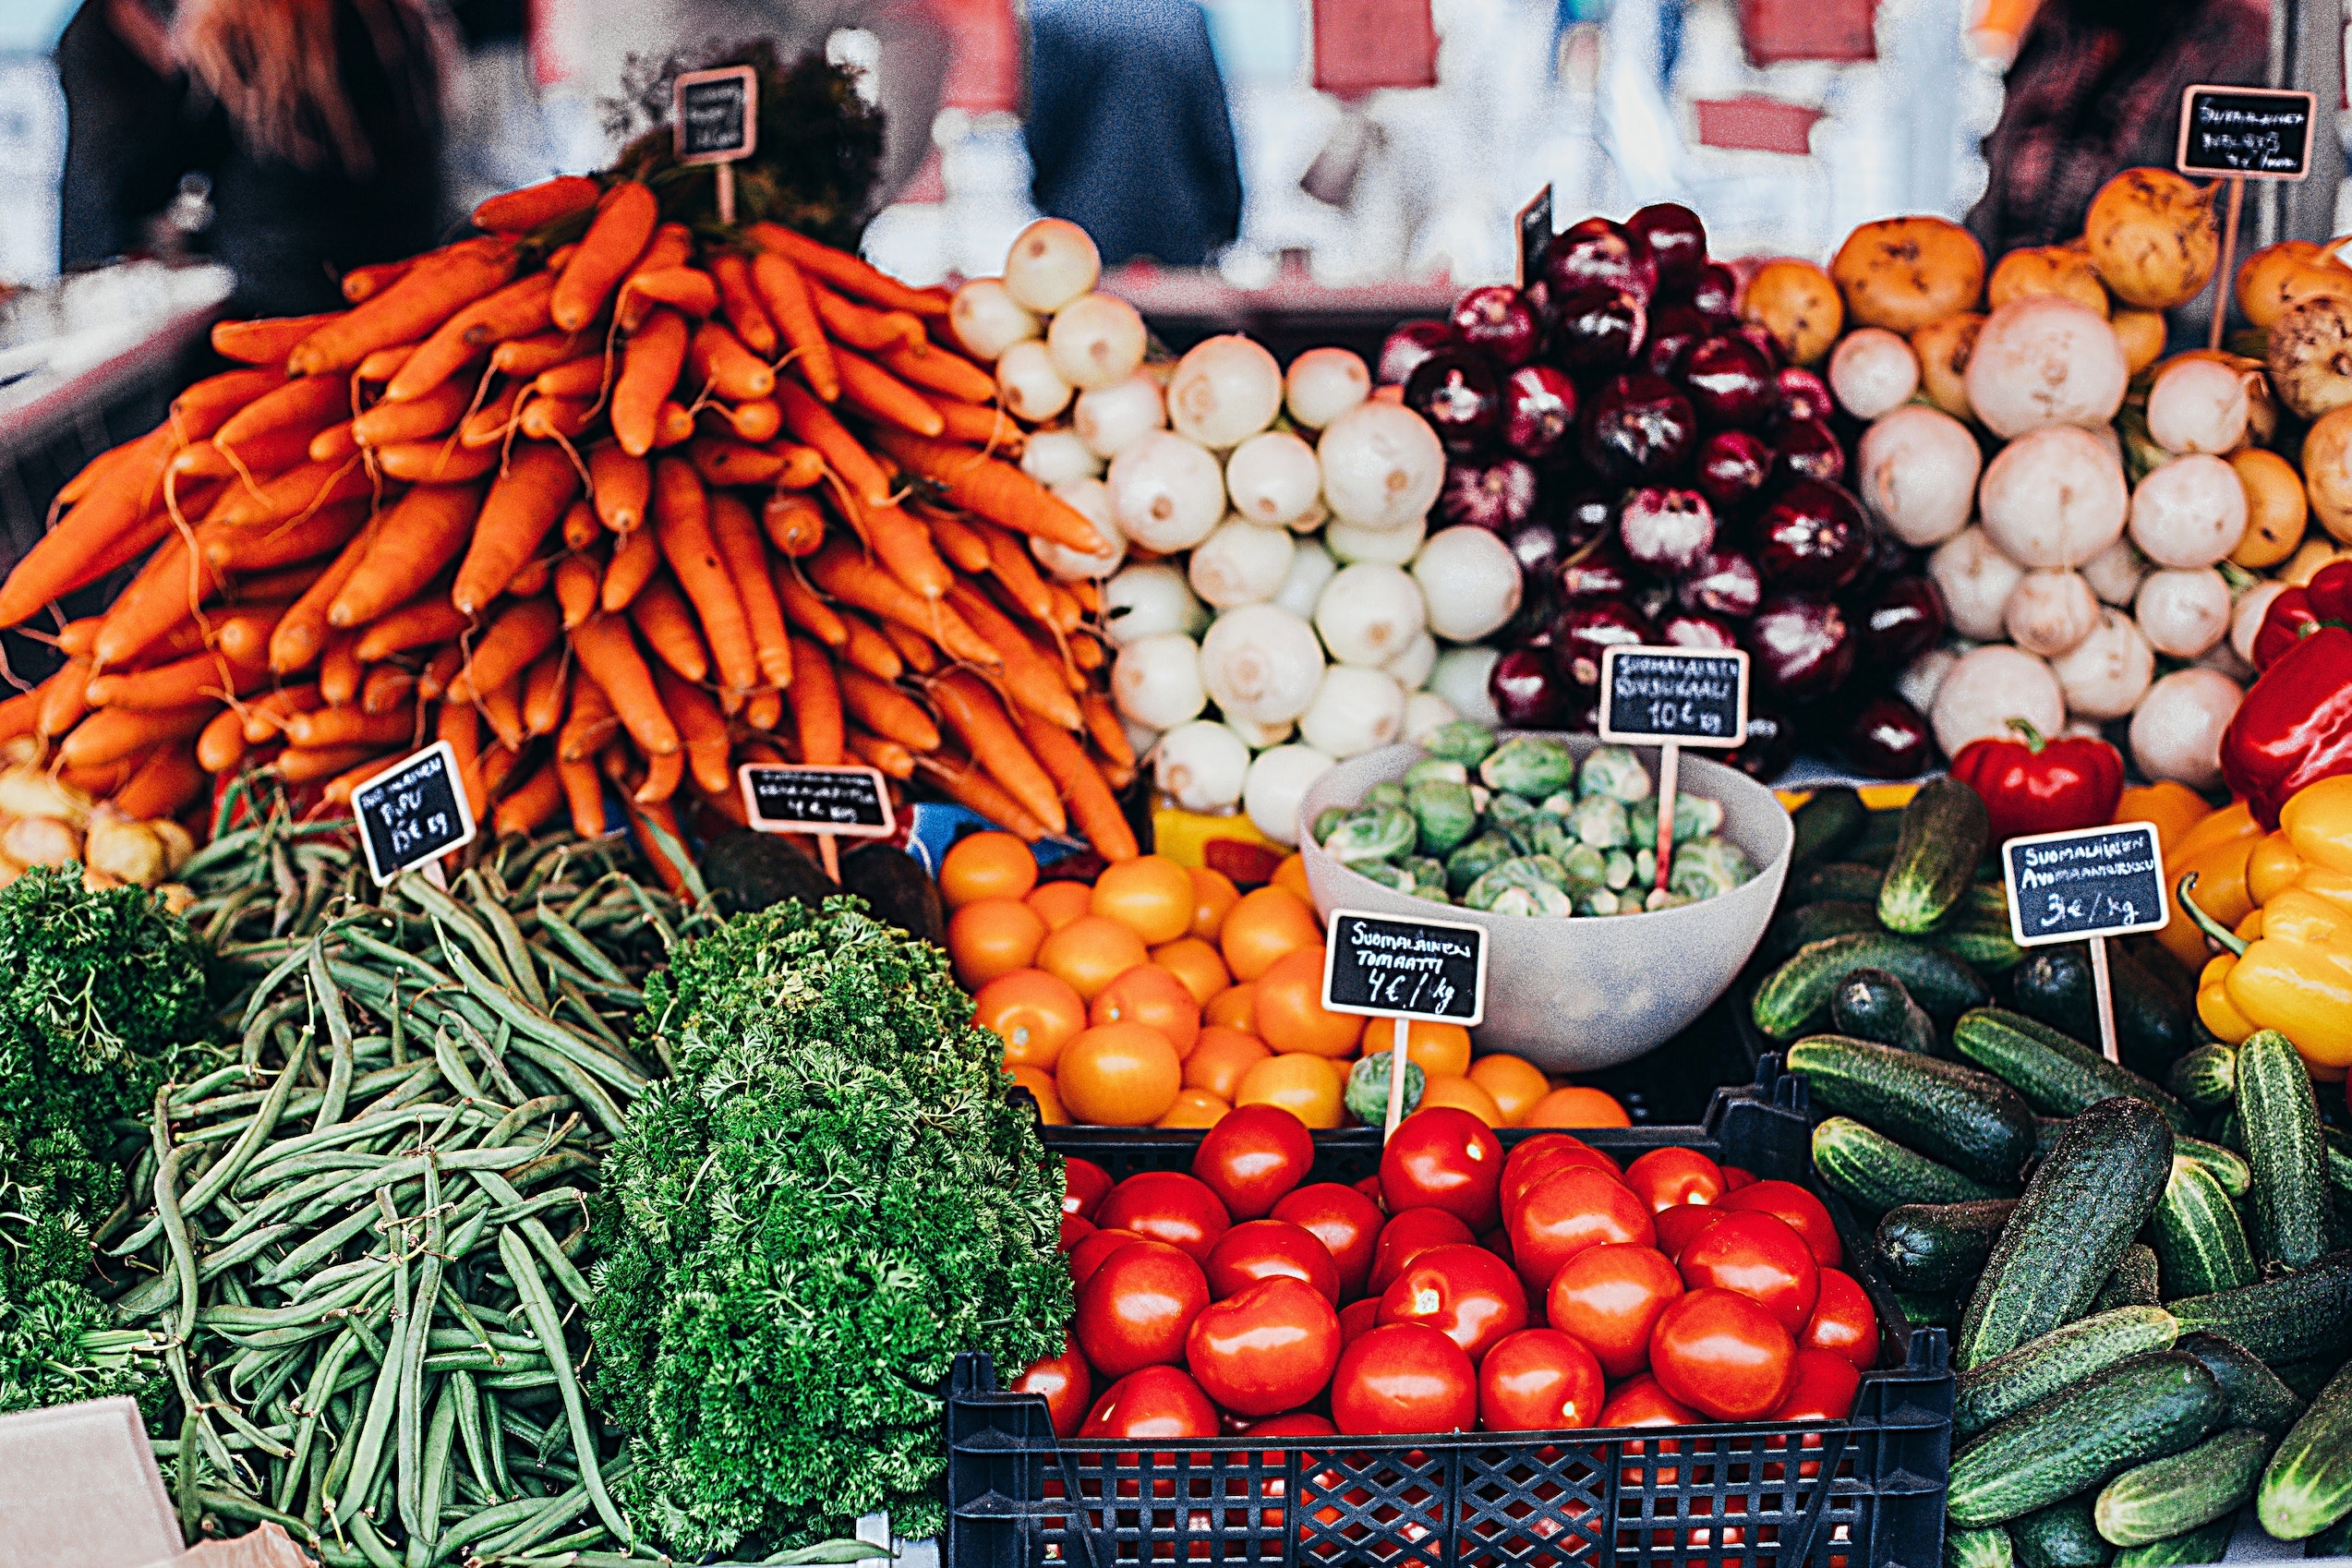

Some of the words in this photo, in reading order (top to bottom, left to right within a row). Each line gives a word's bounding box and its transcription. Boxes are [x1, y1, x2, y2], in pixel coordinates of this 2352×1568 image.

[2025, 837, 2145, 867] SUOMALAINEN
[1351, 921, 1471, 959] SUOMALAINEN
[1357, 949, 1443, 974] TOMAATTI
